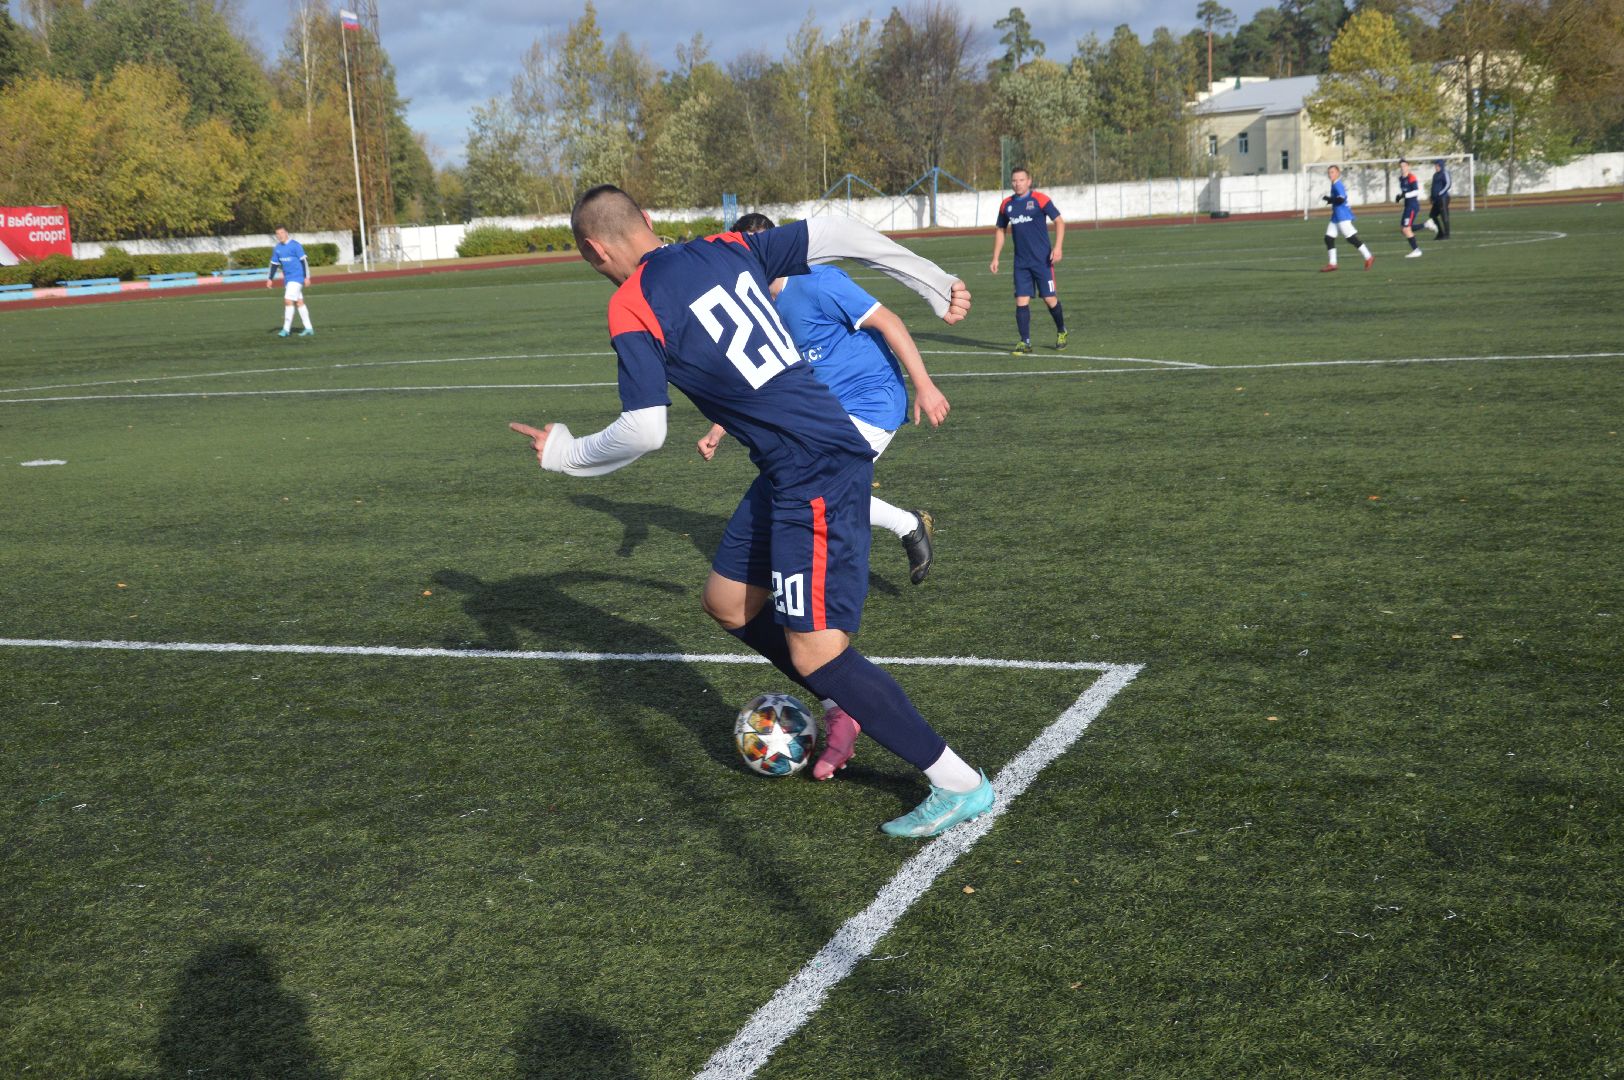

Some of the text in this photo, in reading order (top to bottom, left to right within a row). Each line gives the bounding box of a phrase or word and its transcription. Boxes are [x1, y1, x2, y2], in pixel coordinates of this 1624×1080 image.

[7, 213, 65, 229] выбираю
[28, 227, 67, 244] спорт!
[688, 270, 801, 391] 20
[771, 570, 805, 617] 20
